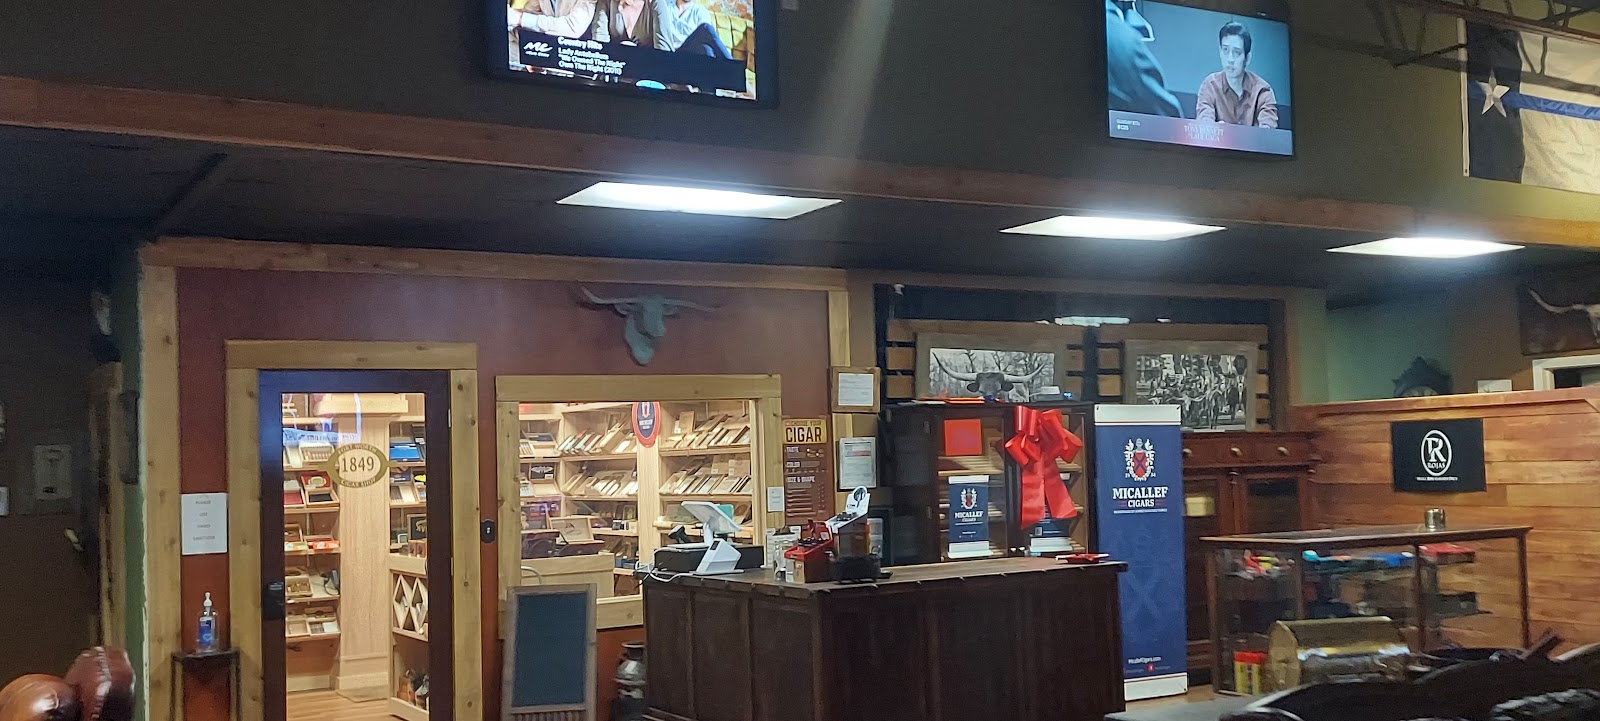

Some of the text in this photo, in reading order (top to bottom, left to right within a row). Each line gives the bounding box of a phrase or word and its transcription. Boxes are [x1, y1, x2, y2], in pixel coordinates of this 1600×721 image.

[785, 426, 822, 443] CIGAR
[342, 456, 374, 472] 1849
[1112, 487, 1168, 499] MICALLEF
[1128, 499, 1154, 507] CIGARS
[954, 511, 984, 519] MICALLEF
